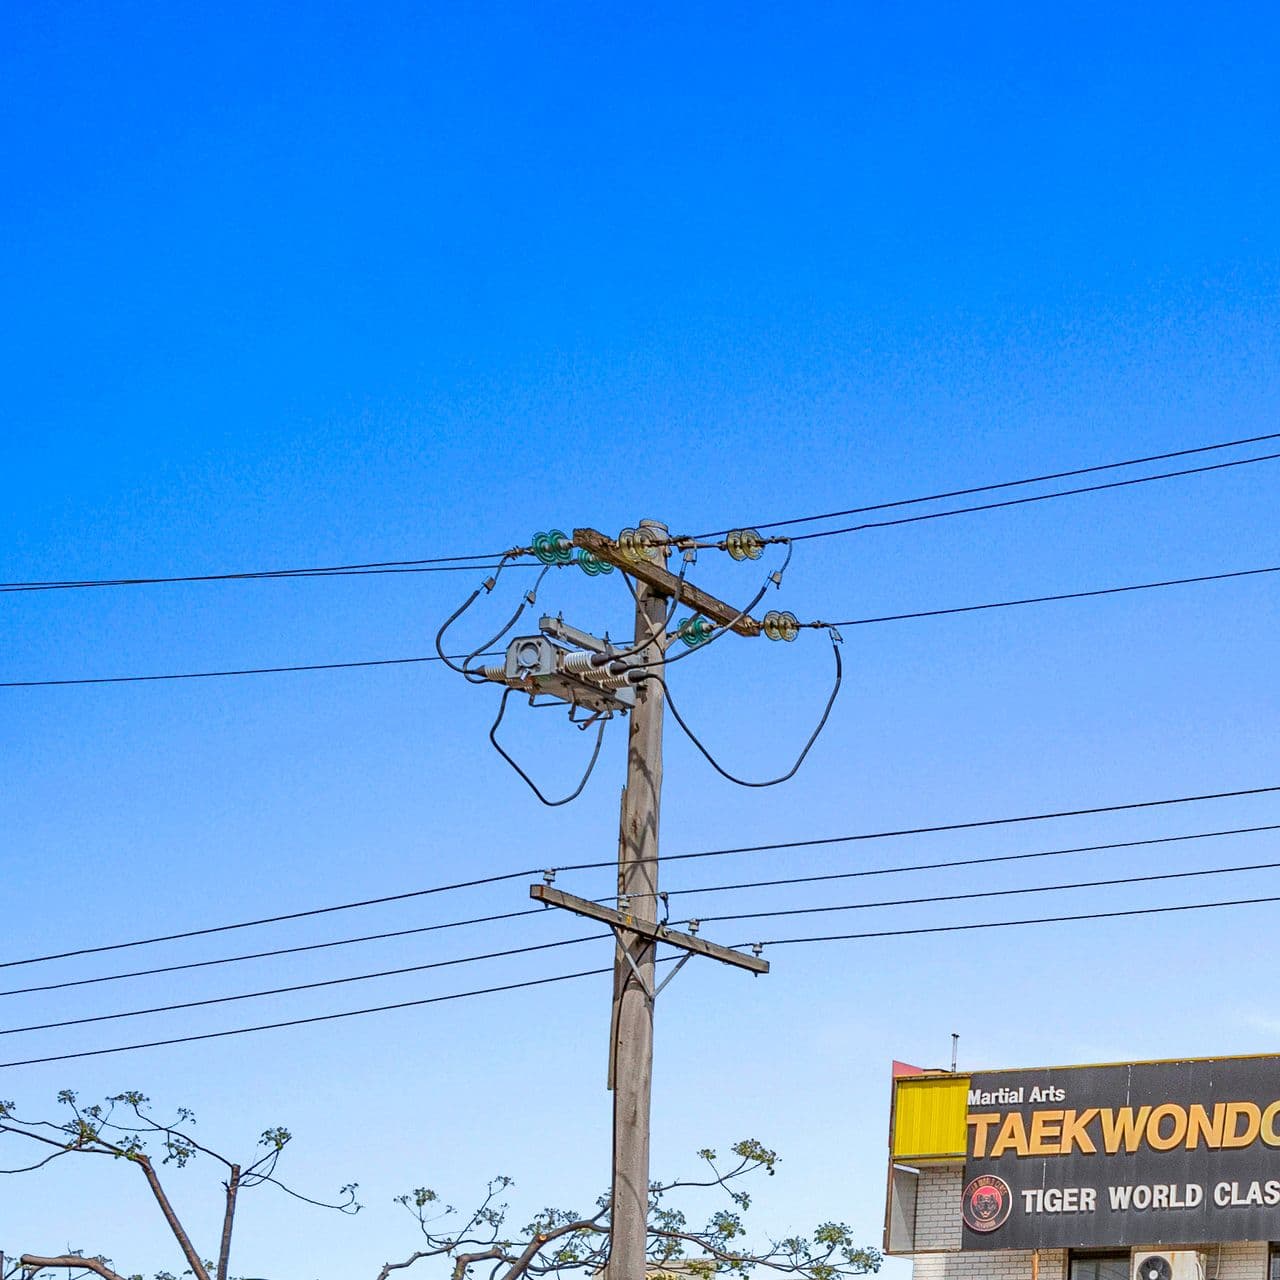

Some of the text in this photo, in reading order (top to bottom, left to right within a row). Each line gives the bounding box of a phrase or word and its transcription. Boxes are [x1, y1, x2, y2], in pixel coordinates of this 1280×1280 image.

[967, 1085, 1066, 1106] Martial Arts
[1021, 1188, 1097, 1214] TIGER
[1108, 1183, 1203, 1210] WORLD
